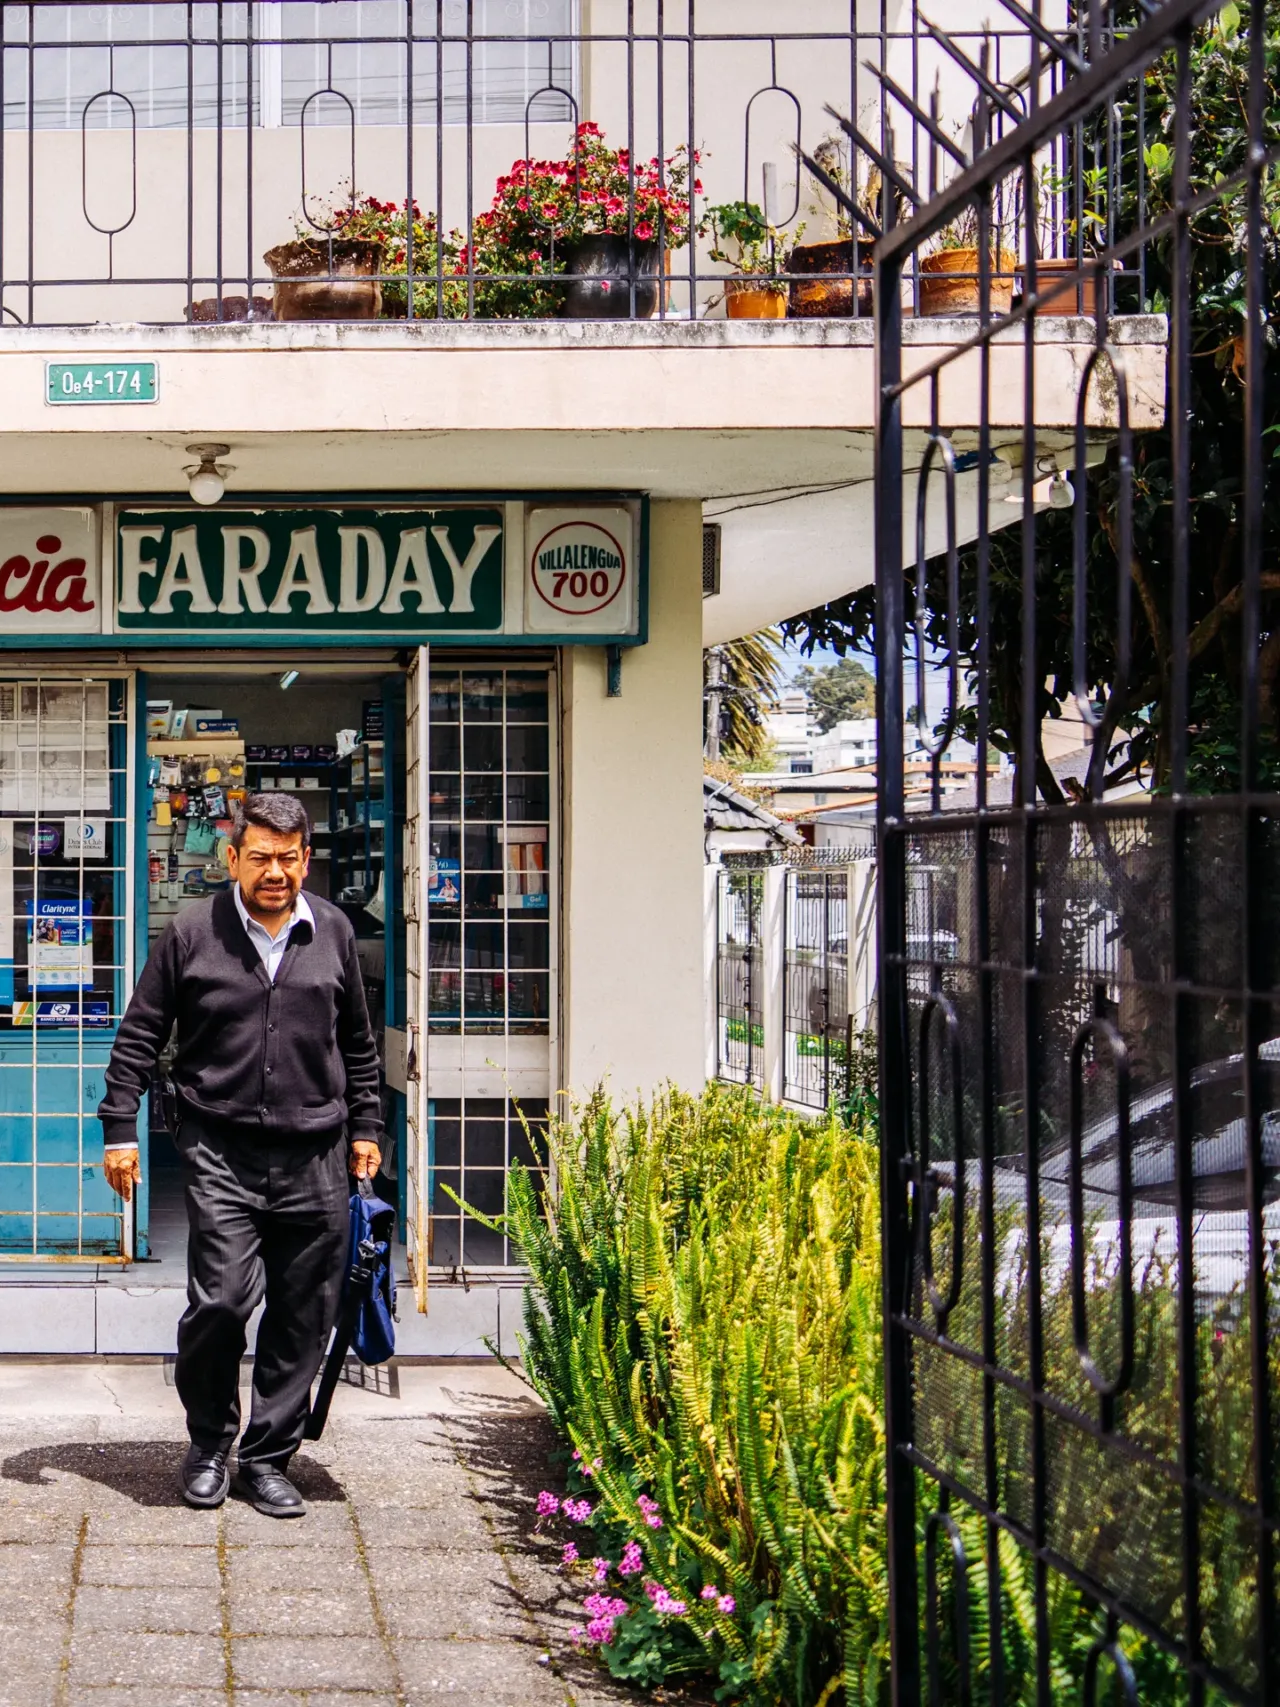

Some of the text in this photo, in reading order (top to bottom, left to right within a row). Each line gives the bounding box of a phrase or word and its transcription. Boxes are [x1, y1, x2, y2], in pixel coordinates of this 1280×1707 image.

[120, 525, 502, 614] FARADAY
[539, 544, 621, 570] VILLALENGUA
[552, 570, 609, 598] 700
[42, 904, 77, 914] Clarityne
